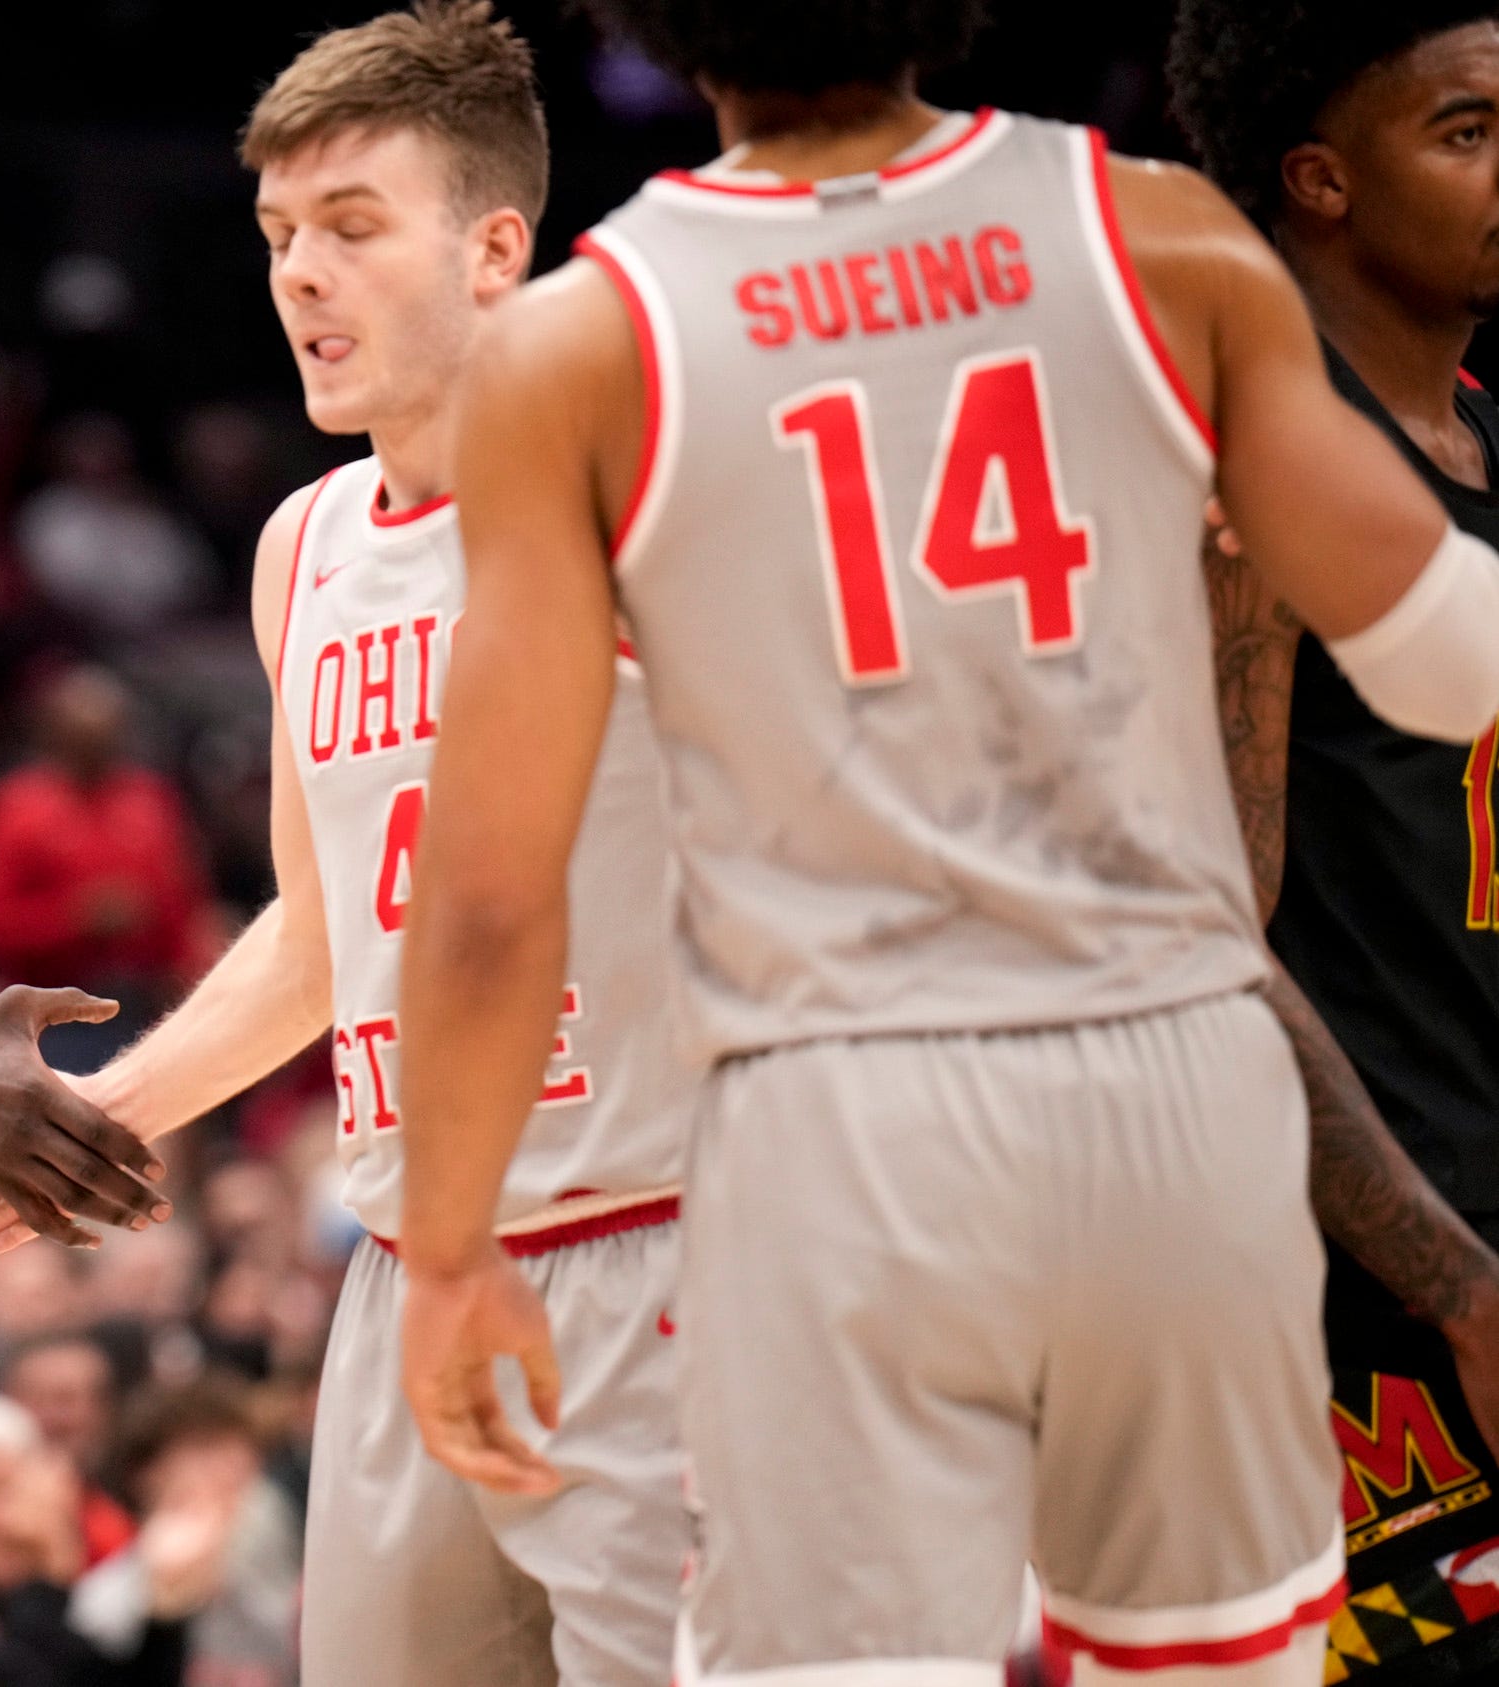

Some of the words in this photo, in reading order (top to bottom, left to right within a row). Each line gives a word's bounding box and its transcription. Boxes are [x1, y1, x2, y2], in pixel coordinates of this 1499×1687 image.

[735, 224, 1032, 350] SUEING
[770, 346, 1094, 686] 14
[310, 608, 466, 764] OHI
